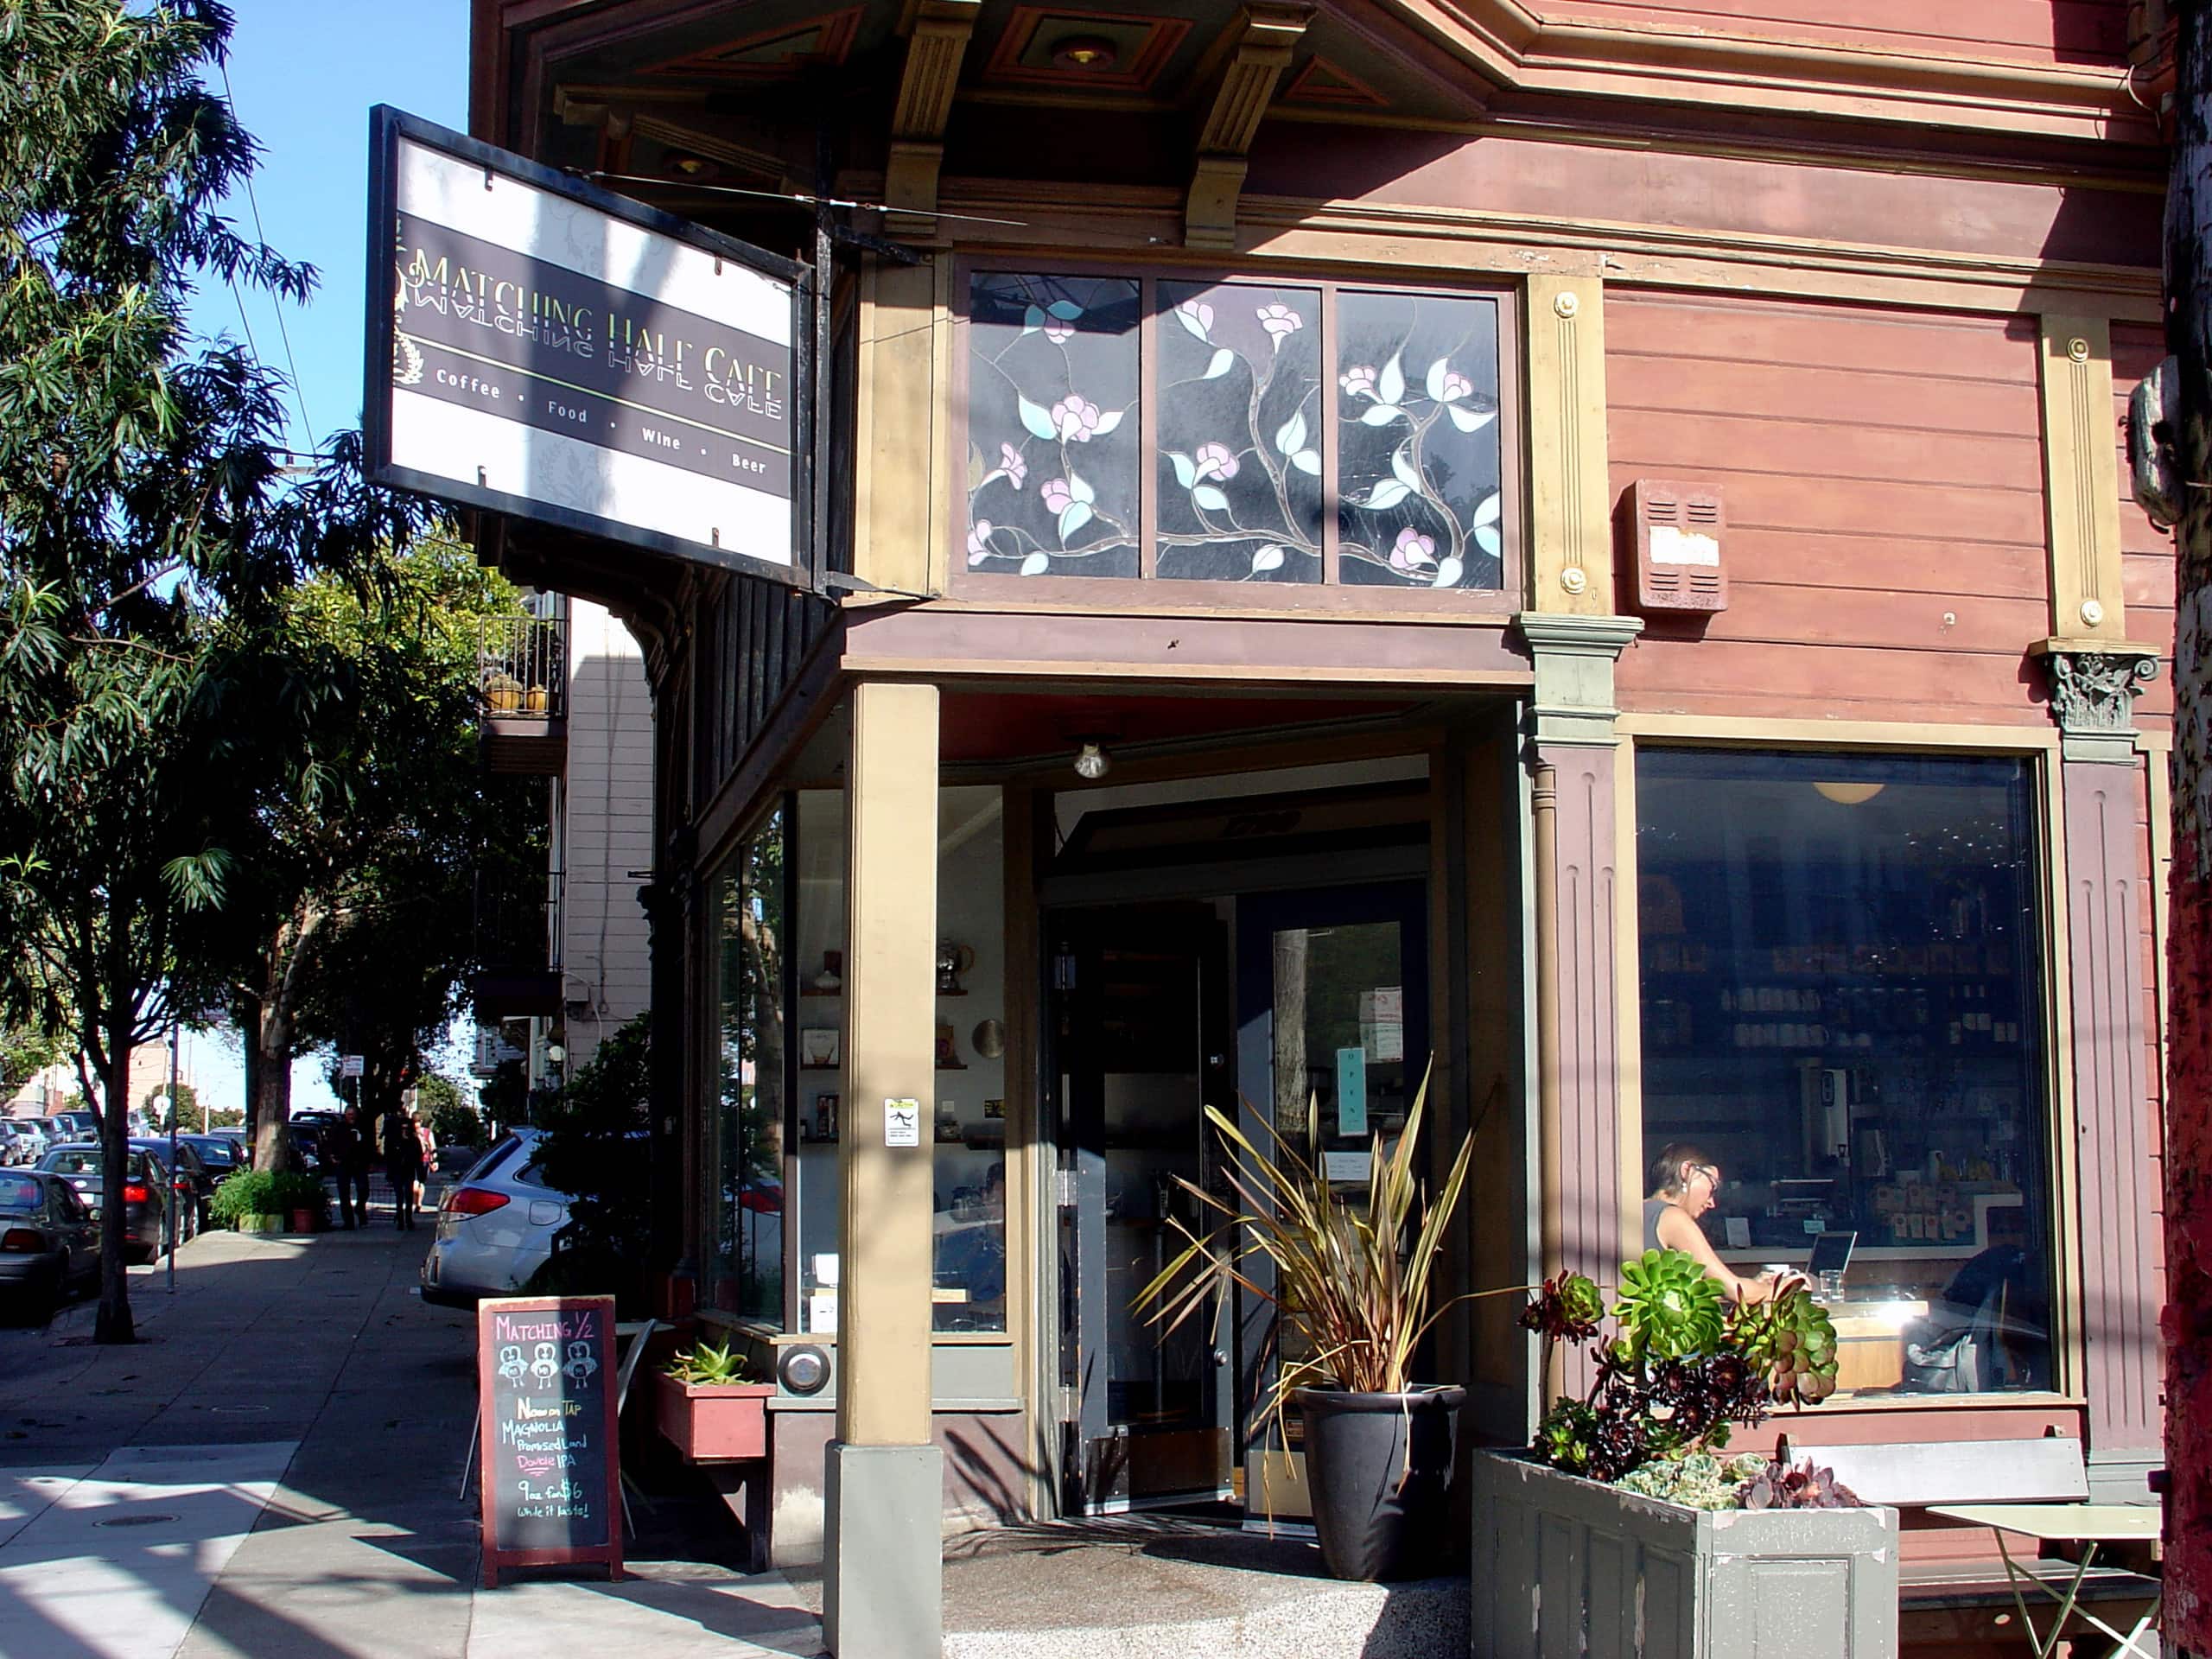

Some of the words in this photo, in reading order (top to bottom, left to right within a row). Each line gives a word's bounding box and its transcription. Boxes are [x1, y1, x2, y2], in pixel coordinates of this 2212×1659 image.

[409, 248, 593, 340] MATCHING
[436, 369, 500, 398] Coffee
[548, 400, 588, 423] Food
[642, 427, 681, 450] Wine
[732, 453, 766, 474] Beer
[496, 1315, 571, 1341] MATCHING
[562, 1400, 582, 1416] TAP
[502, 1418, 564, 1446] MAGNOLIA
[556, 1453, 576, 1469] IPA
[545, 1504, 554, 1517] it
